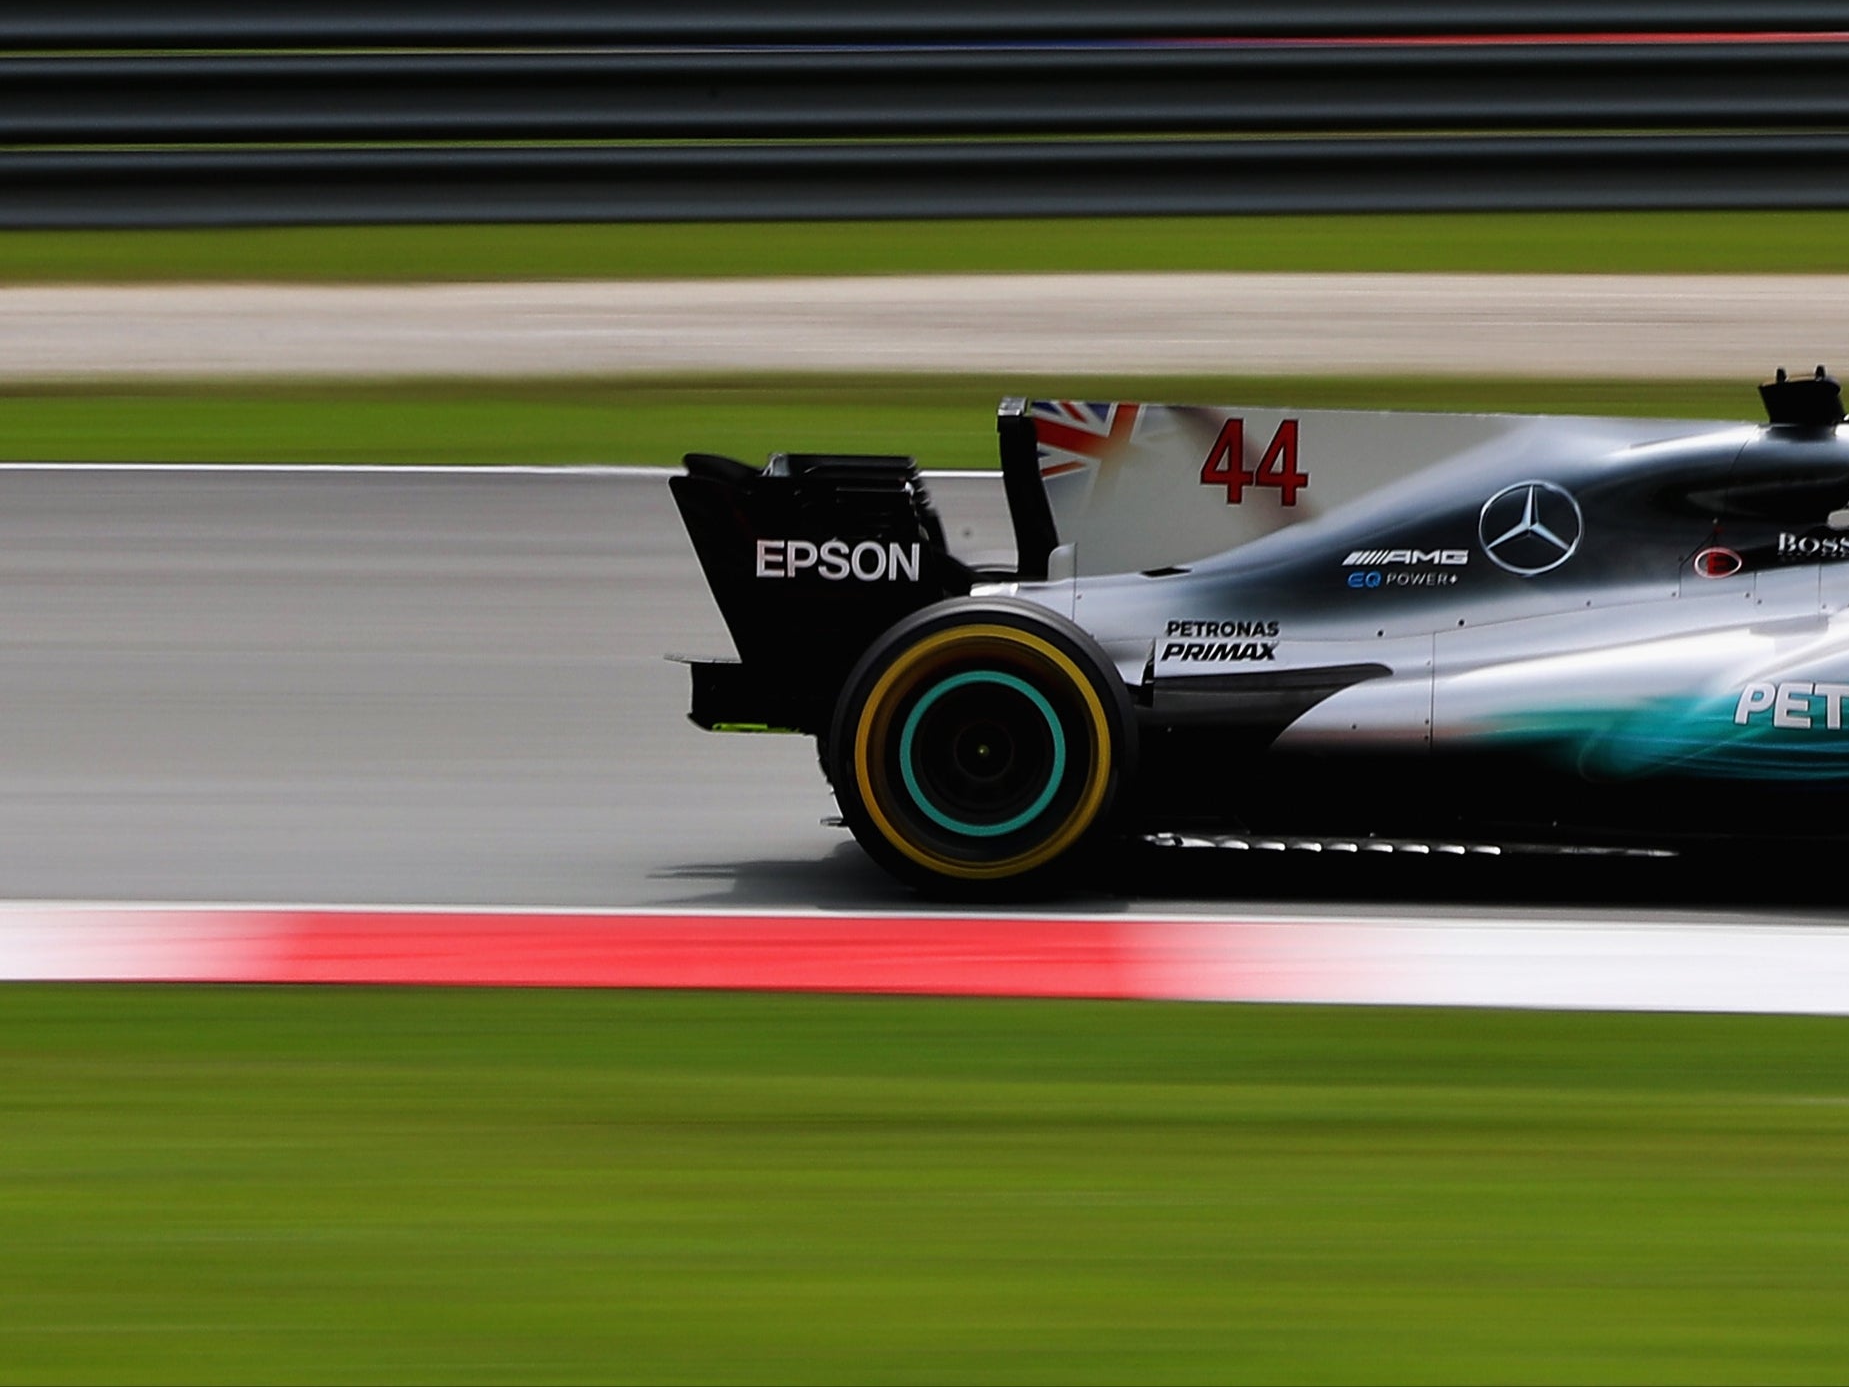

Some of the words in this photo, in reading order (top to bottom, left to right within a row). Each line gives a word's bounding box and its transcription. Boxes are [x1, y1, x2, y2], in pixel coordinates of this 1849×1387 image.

[1200, 417, 1309, 507] 44
[756, 538, 920, 582] EPSON
[1347, 570, 1382, 588] EQ
[1166, 620, 1280, 638] PETRONAS
[1160, 642, 1279, 662] PRIMAX
